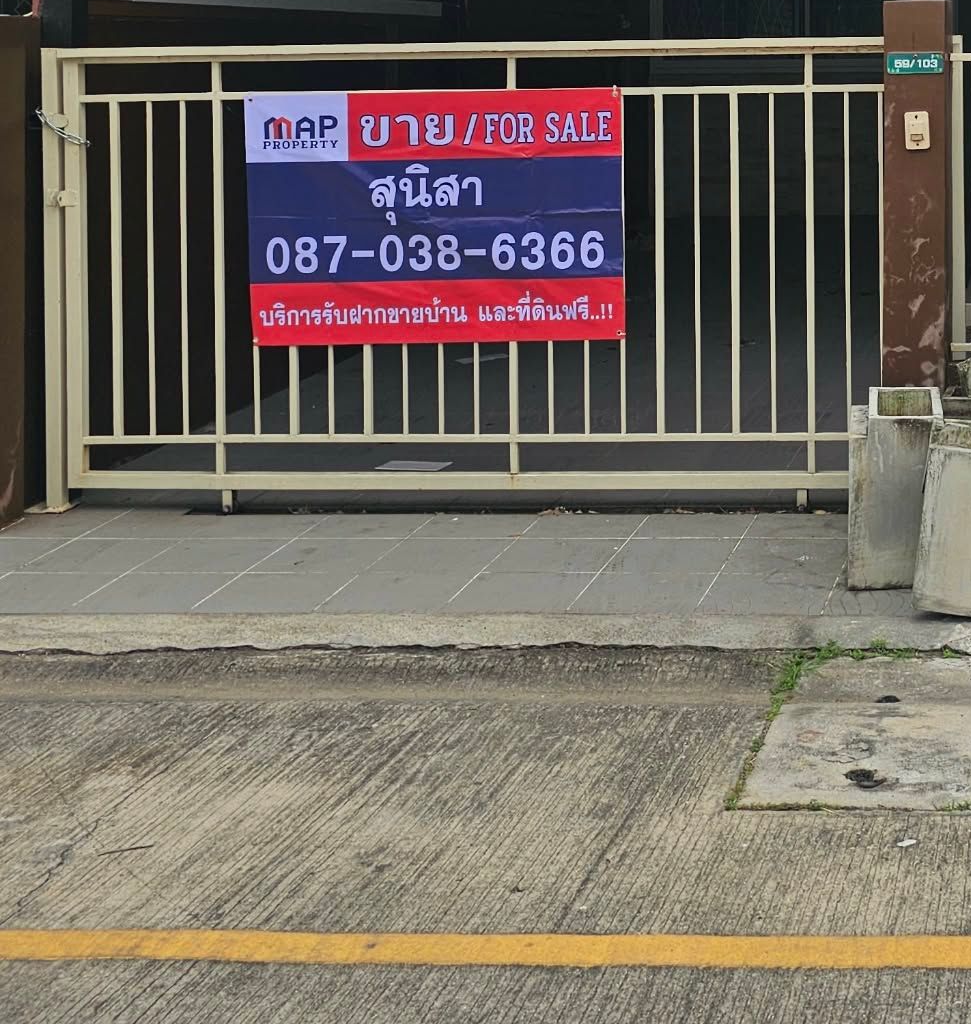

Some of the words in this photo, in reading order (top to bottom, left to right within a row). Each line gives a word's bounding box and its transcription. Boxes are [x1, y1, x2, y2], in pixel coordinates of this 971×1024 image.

[263, 115, 338, 140] MAP
[359, 113, 455, 147] ขาย
[544, 110, 613, 144] SALE
[263, 139, 338, 150] PROPERTY
[368, 163, 483, 226] สุนิสา
[265, 230, 606, 275] 087-038-6366
[259, 297, 468, 327] บริการรับฝากขายบ้าน
